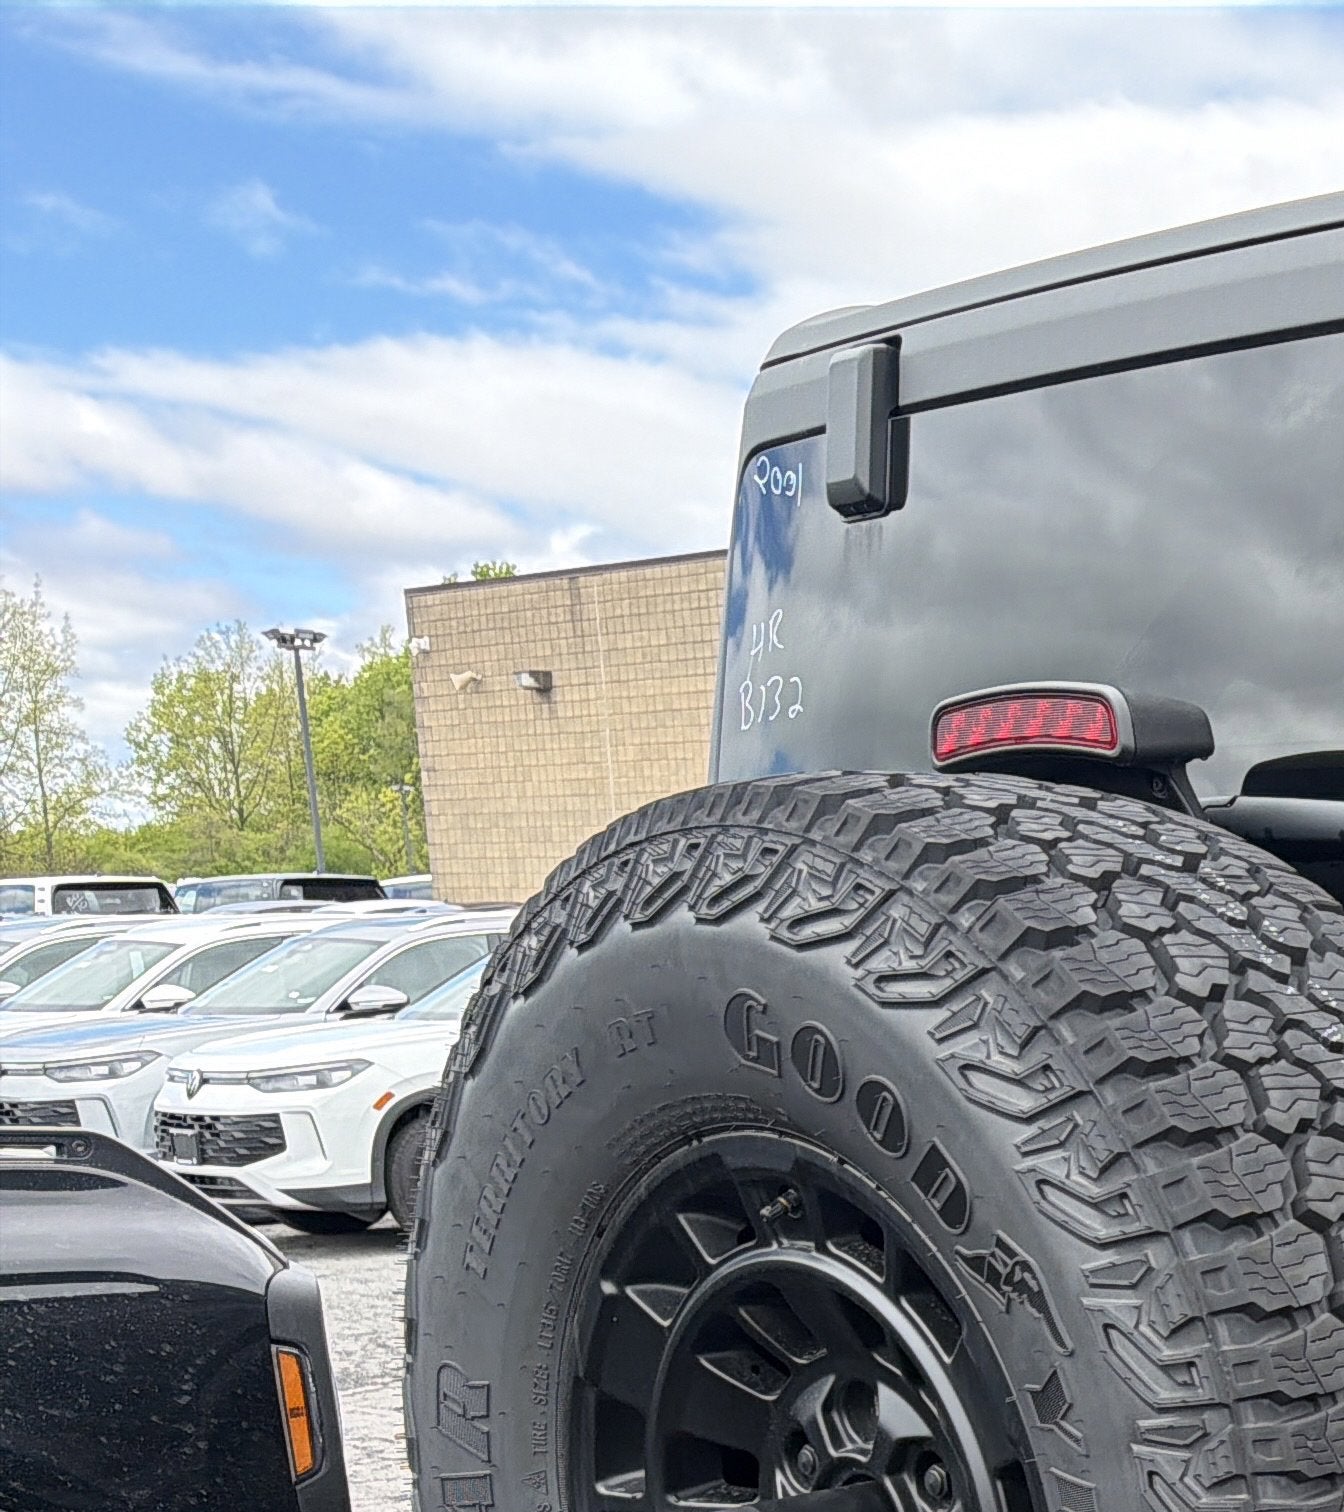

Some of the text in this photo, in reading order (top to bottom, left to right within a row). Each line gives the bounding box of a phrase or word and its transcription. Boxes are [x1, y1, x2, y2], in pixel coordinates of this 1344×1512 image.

[739, 675, 804, 731] B132
[463, 1008, 656, 1280] TERRITORY RT
[531, 1421, 548, 1456] TIRE
